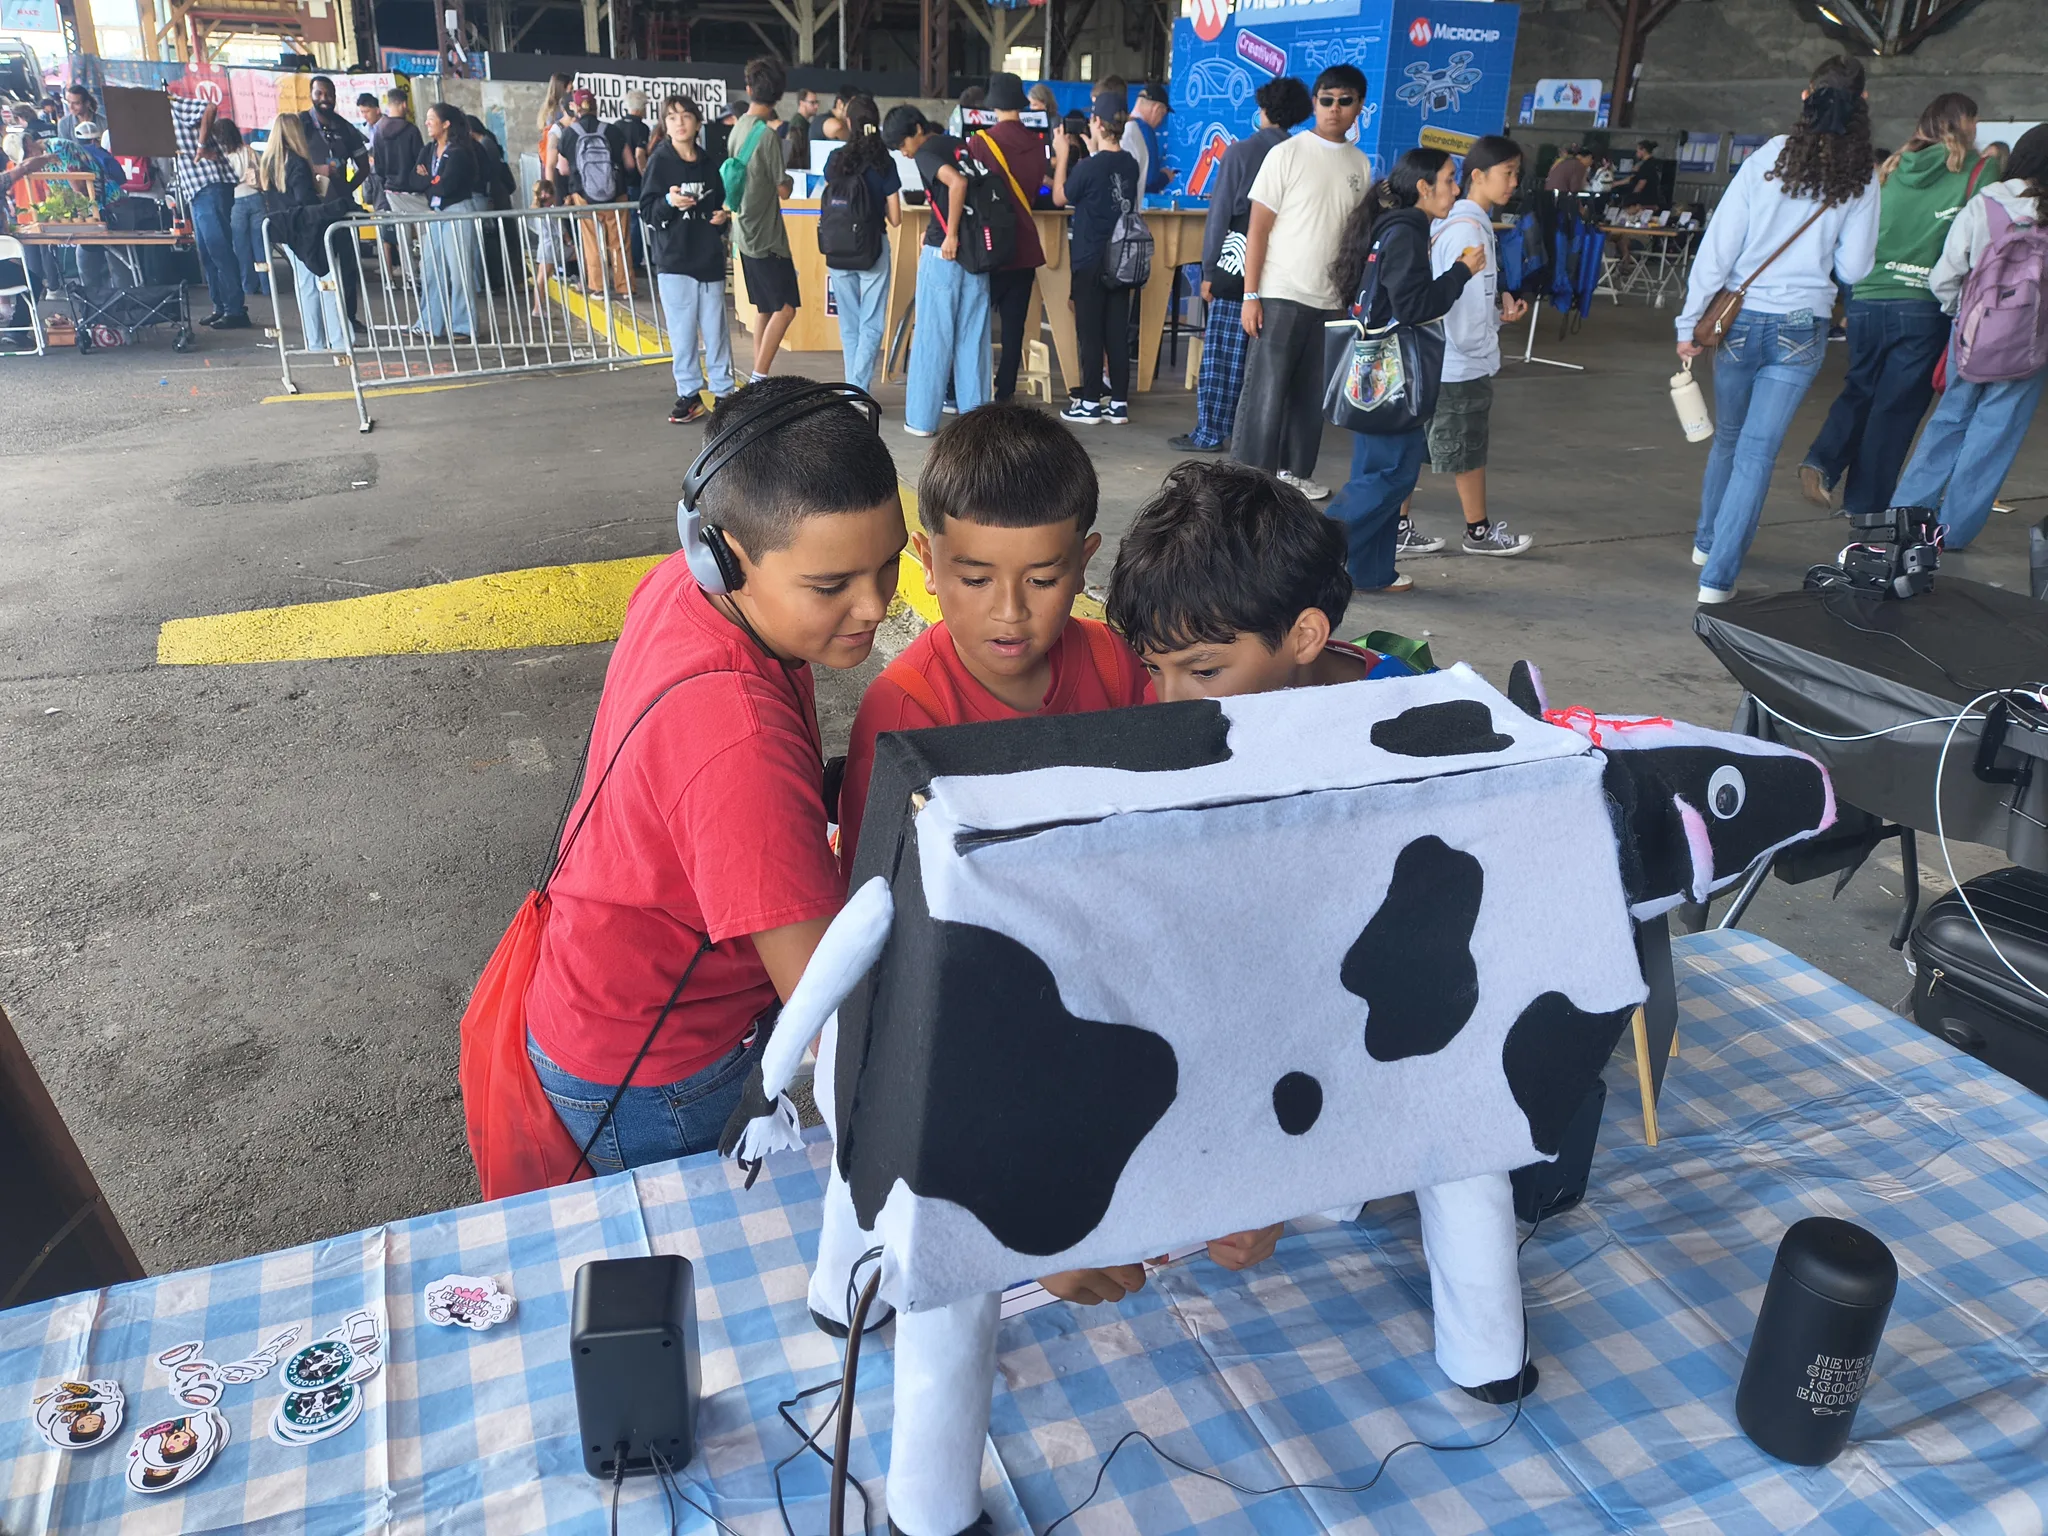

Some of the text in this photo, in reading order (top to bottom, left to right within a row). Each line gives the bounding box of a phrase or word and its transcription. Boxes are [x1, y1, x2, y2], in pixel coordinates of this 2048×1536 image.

[1239, 34, 1283, 73] Creativity
[440, 1291, 487, 1308] MAYHEM
[330, 1342, 352, 1364] COFFEE
[290, 1375, 325, 1387] MOOSIC
[1816, 1378, 1865, 1394] GOOD
[1796, 1386, 1860, 1405] ENOUG
[295, 1411, 336, 1425] COFFEE
